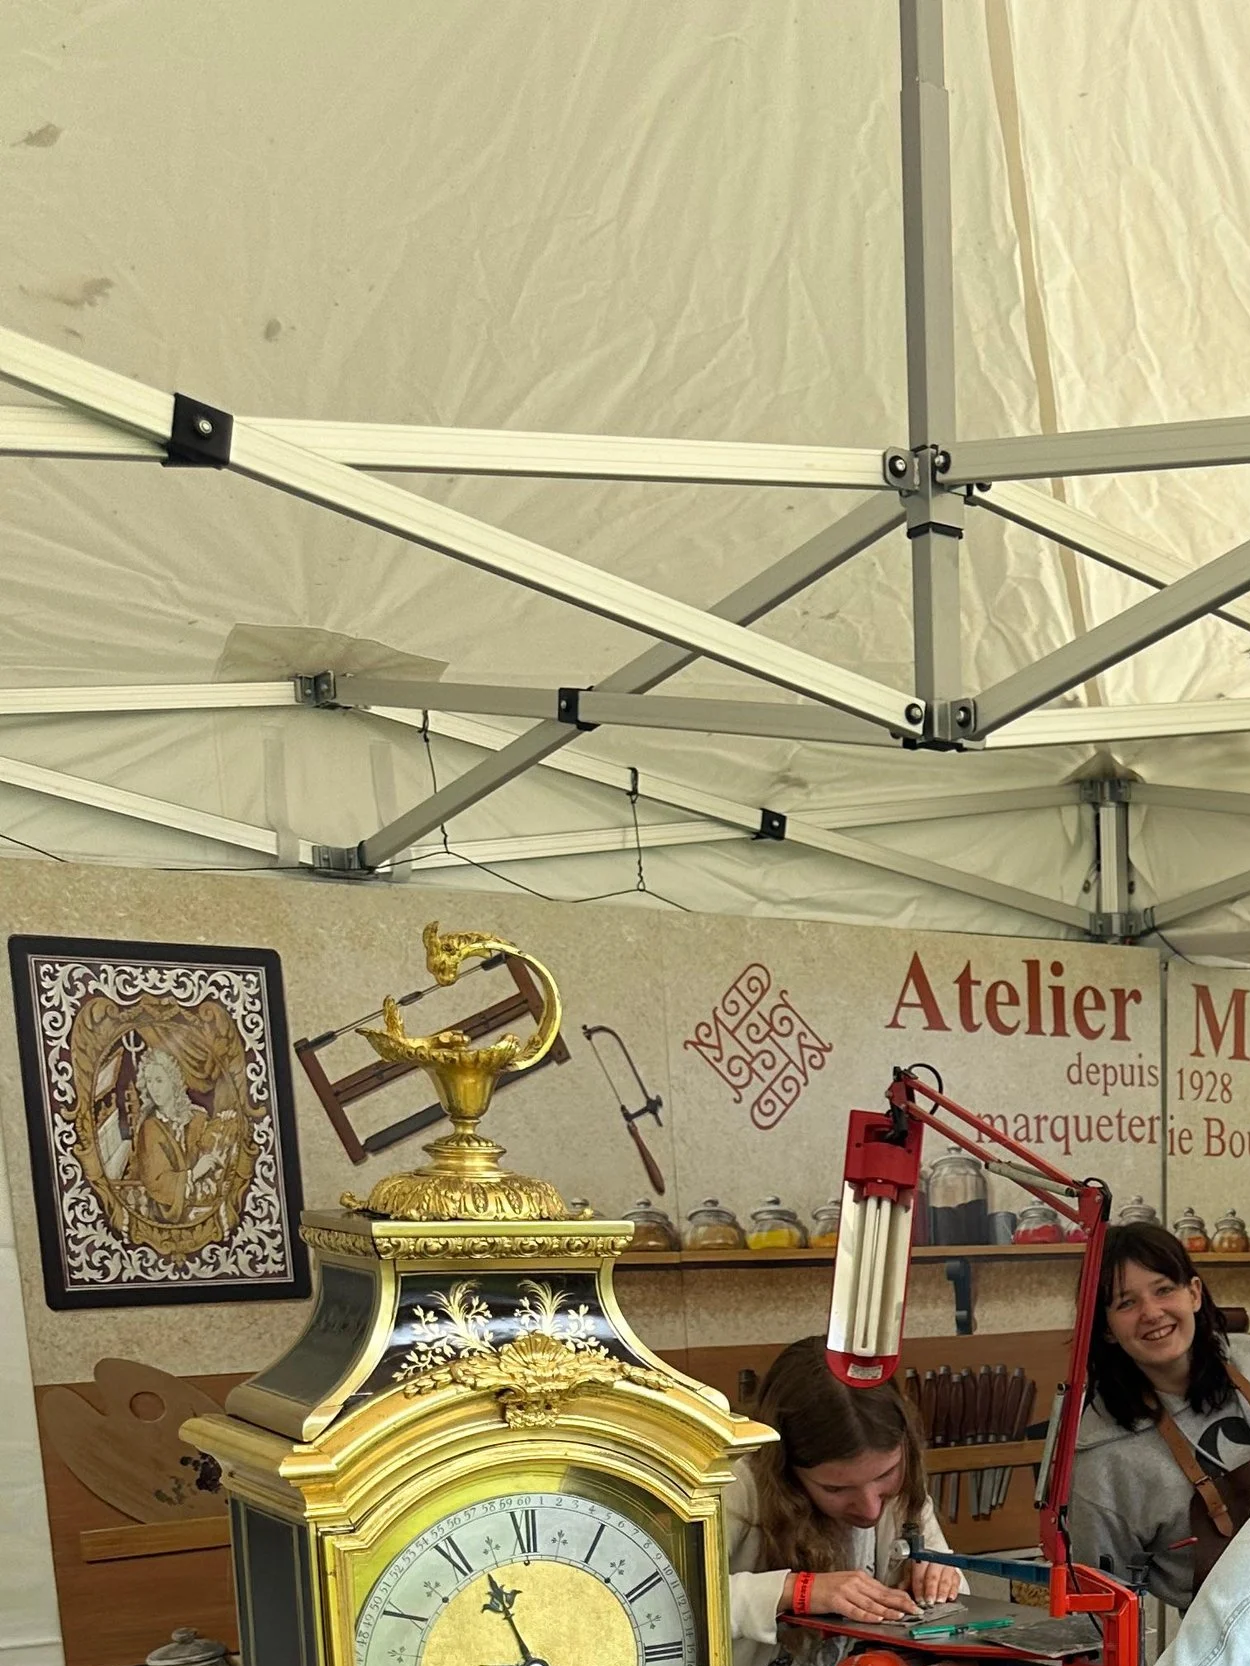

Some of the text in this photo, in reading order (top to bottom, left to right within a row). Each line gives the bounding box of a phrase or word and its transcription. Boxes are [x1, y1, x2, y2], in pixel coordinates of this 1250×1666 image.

[884, 950, 1143, 1041] Atelier
[1066, 1051, 1233, 1104] depuis 1928
[500, 1498, 512, 1509] 59
[517, 1496, 531, 1506] 60
[539, 1497, 544, 1505] 1
[555, 1498, 563, 1507] 2
[572, 1500, 580, 1509] 3
[463, 1508, 476, 1520] 57
[482, 1502, 496, 1514] 58
[588, 1505, 596, 1514] 4
[604, 1512, 612, 1521] 5
[447, 1518, 461, 1528] 56
[618, 1520, 625, 1528] 6
[431, 1524, 445, 1538] 55
[508, 1509, 538, 1556] XII
[416, 1537, 429, 1549] 54
[582, 1521, 607, 1564] I
[643, 1539, 652, 1548] 8
[402, 1550, 417, 1563] 53
[429, 1534, 474, 1584] XI
[389, 1564, 404, 1579] 52
[663, 1565, 674, 1576] 10
[380, 1581, 392, 1594] 51
[623, 1569, 665, 1604] II
[671, 1580, 679, 1589] 11
[370, 1596, 383, 1610] 50
[678, 1592, 687, 1606] 12
[363, 1615, 375, 1628] 49
[381, 1600, 429, 1635] X
[682, 1611, 692, 1621] 13
[685, 1628, 694, 1637] 14
[644, 1640, 684, 1664] III
[687, 1644, 695, 1654] 15
